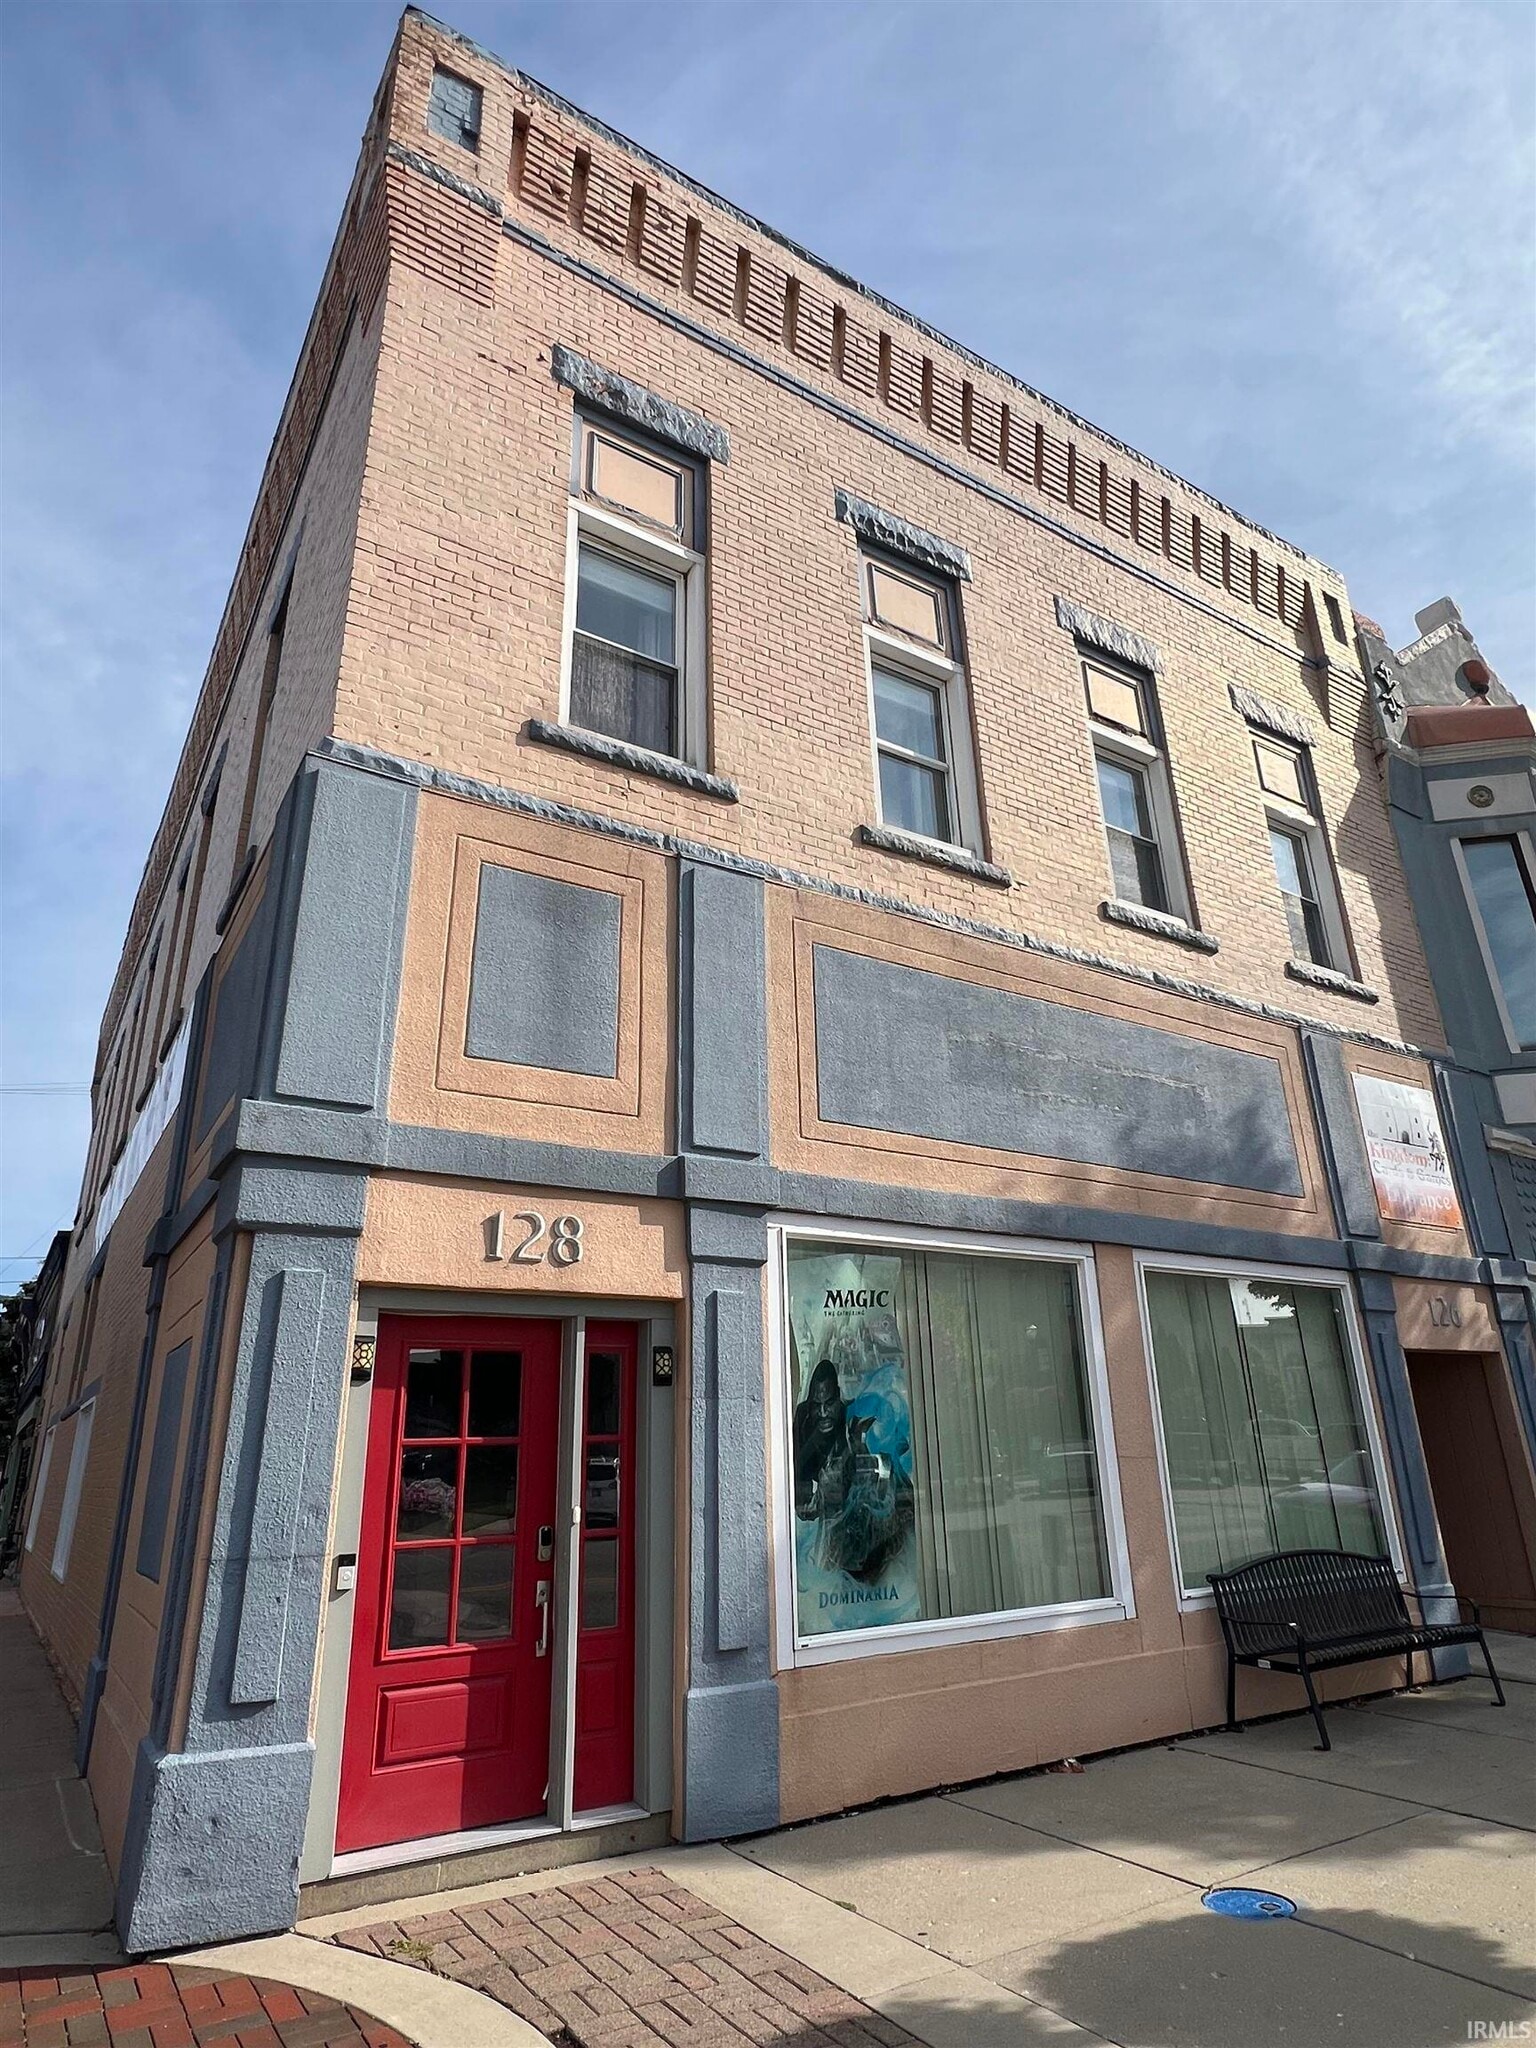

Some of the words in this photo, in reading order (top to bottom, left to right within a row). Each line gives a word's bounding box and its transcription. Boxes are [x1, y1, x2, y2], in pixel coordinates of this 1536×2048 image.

[480, 1209, 584, 1268] 128
[823, 1289, 890, 1309] MAGIC
[818, 1583, 899, 1608] DOMINARIA
